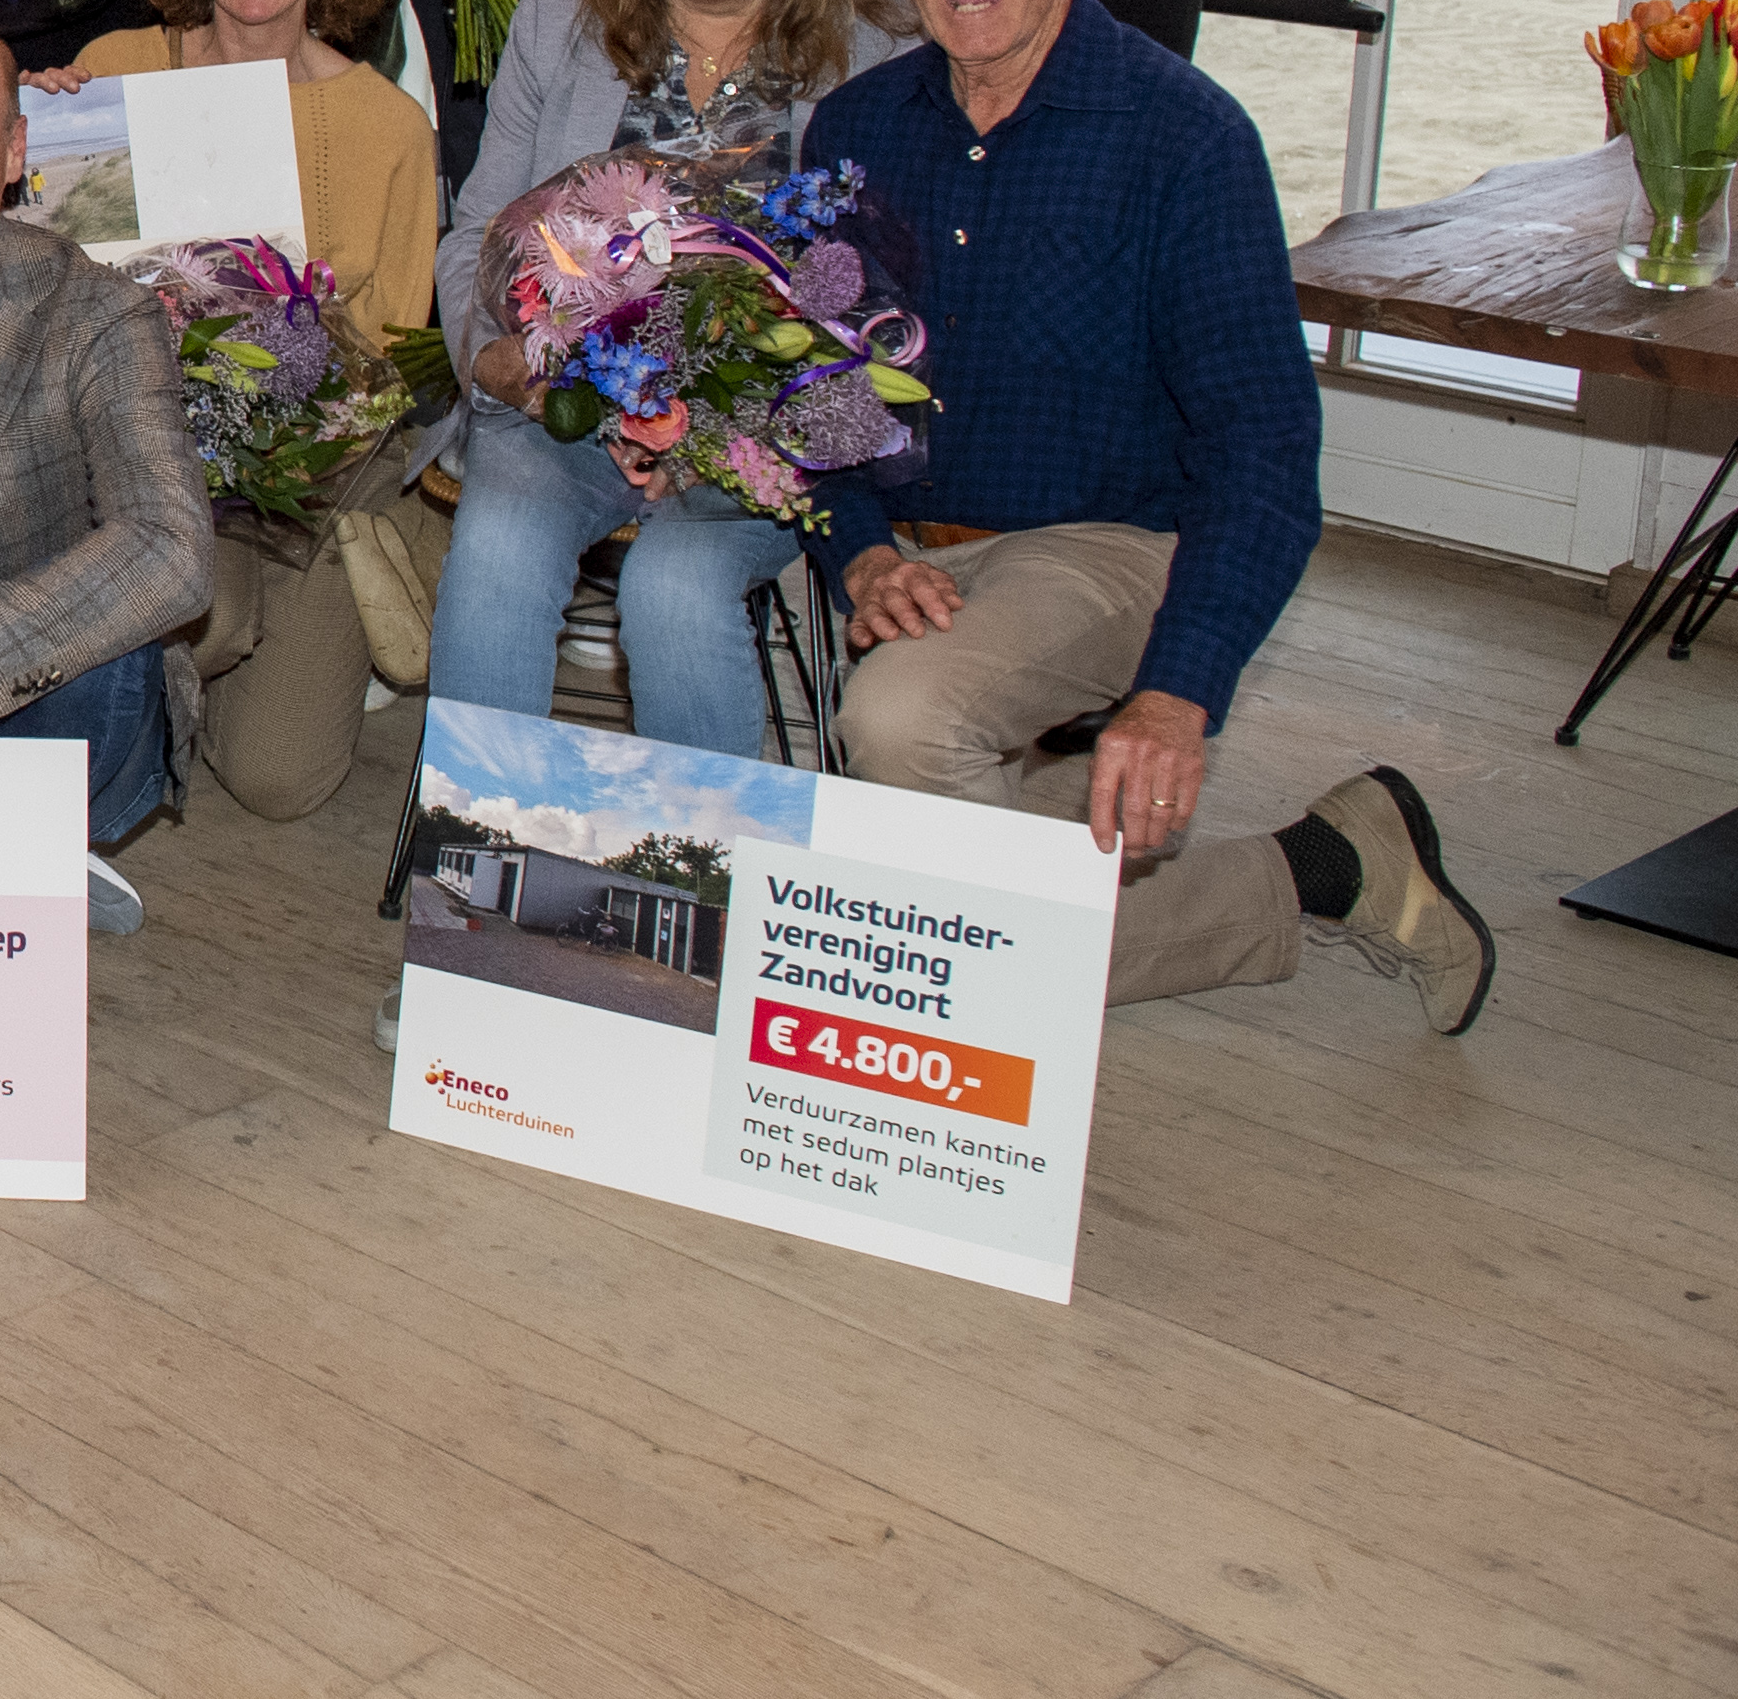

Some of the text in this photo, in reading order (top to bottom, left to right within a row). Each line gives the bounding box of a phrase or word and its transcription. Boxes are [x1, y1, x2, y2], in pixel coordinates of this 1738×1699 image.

[766, 875, 1015, 953] Volkstuinder-
[759, 951, 953, 1020] Zandvoort
[763, 921, 953, 986] vereniging
[441, 1068, 509, 1102] Eneco
[767, 1015, 983, 1102] € 4.800,-
[446, 1095, 575, 1140] Luchterduinen
[746, 1082, 1047, 1175] Verduurzamen kantine
[739, 1149, 879, 1198] op het dak
[743, 1119, 1007, 1198] met sedum plantjes
